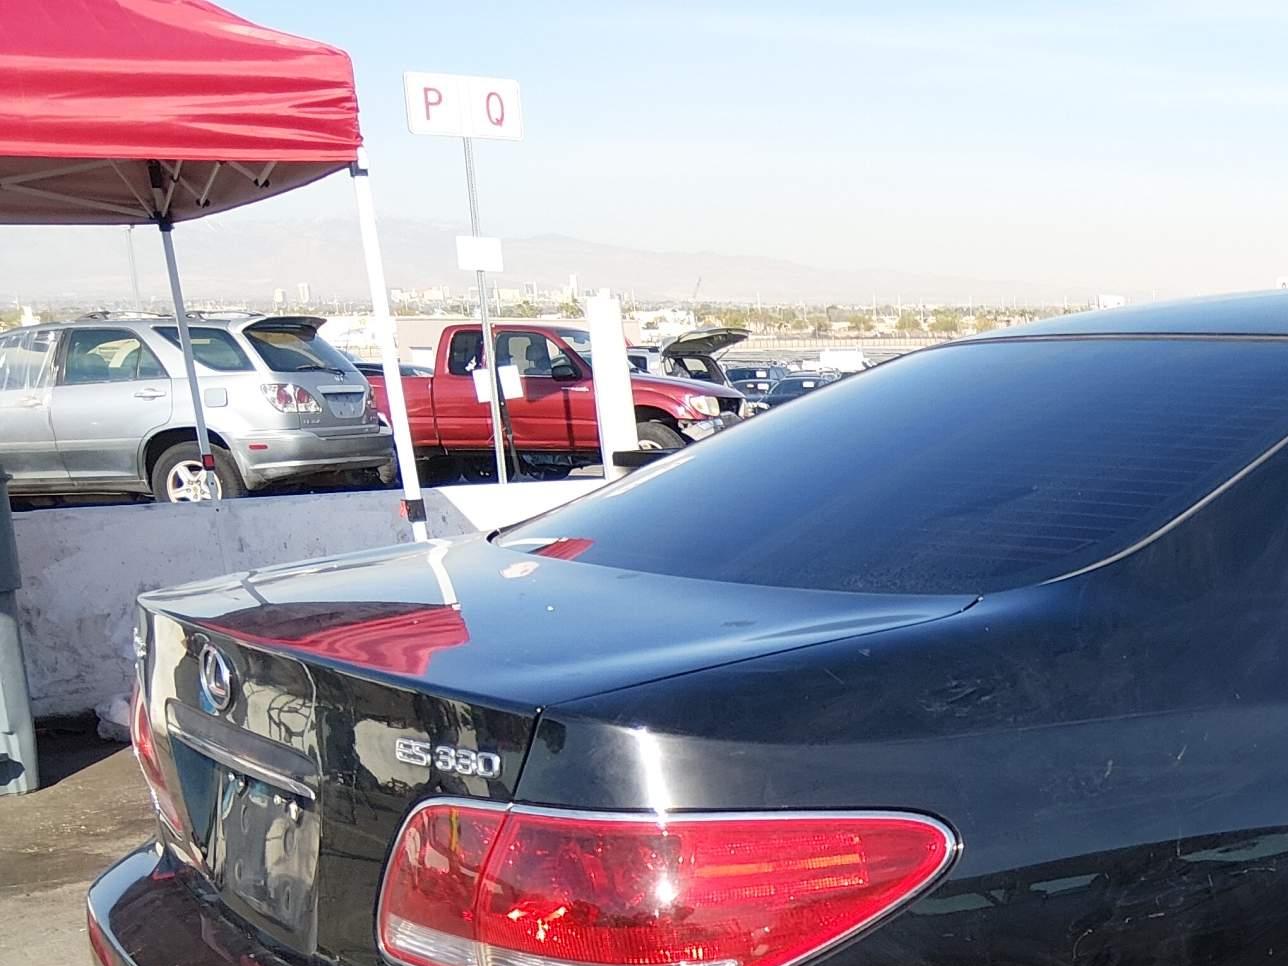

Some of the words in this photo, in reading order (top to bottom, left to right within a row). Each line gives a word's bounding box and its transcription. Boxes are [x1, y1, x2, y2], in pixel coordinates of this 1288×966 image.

[423, 86, 443, 121] P
[485, 91, 505, 127] Q
[395, 738, 432, 767] ES
[434, 745, 501, 779] 330
